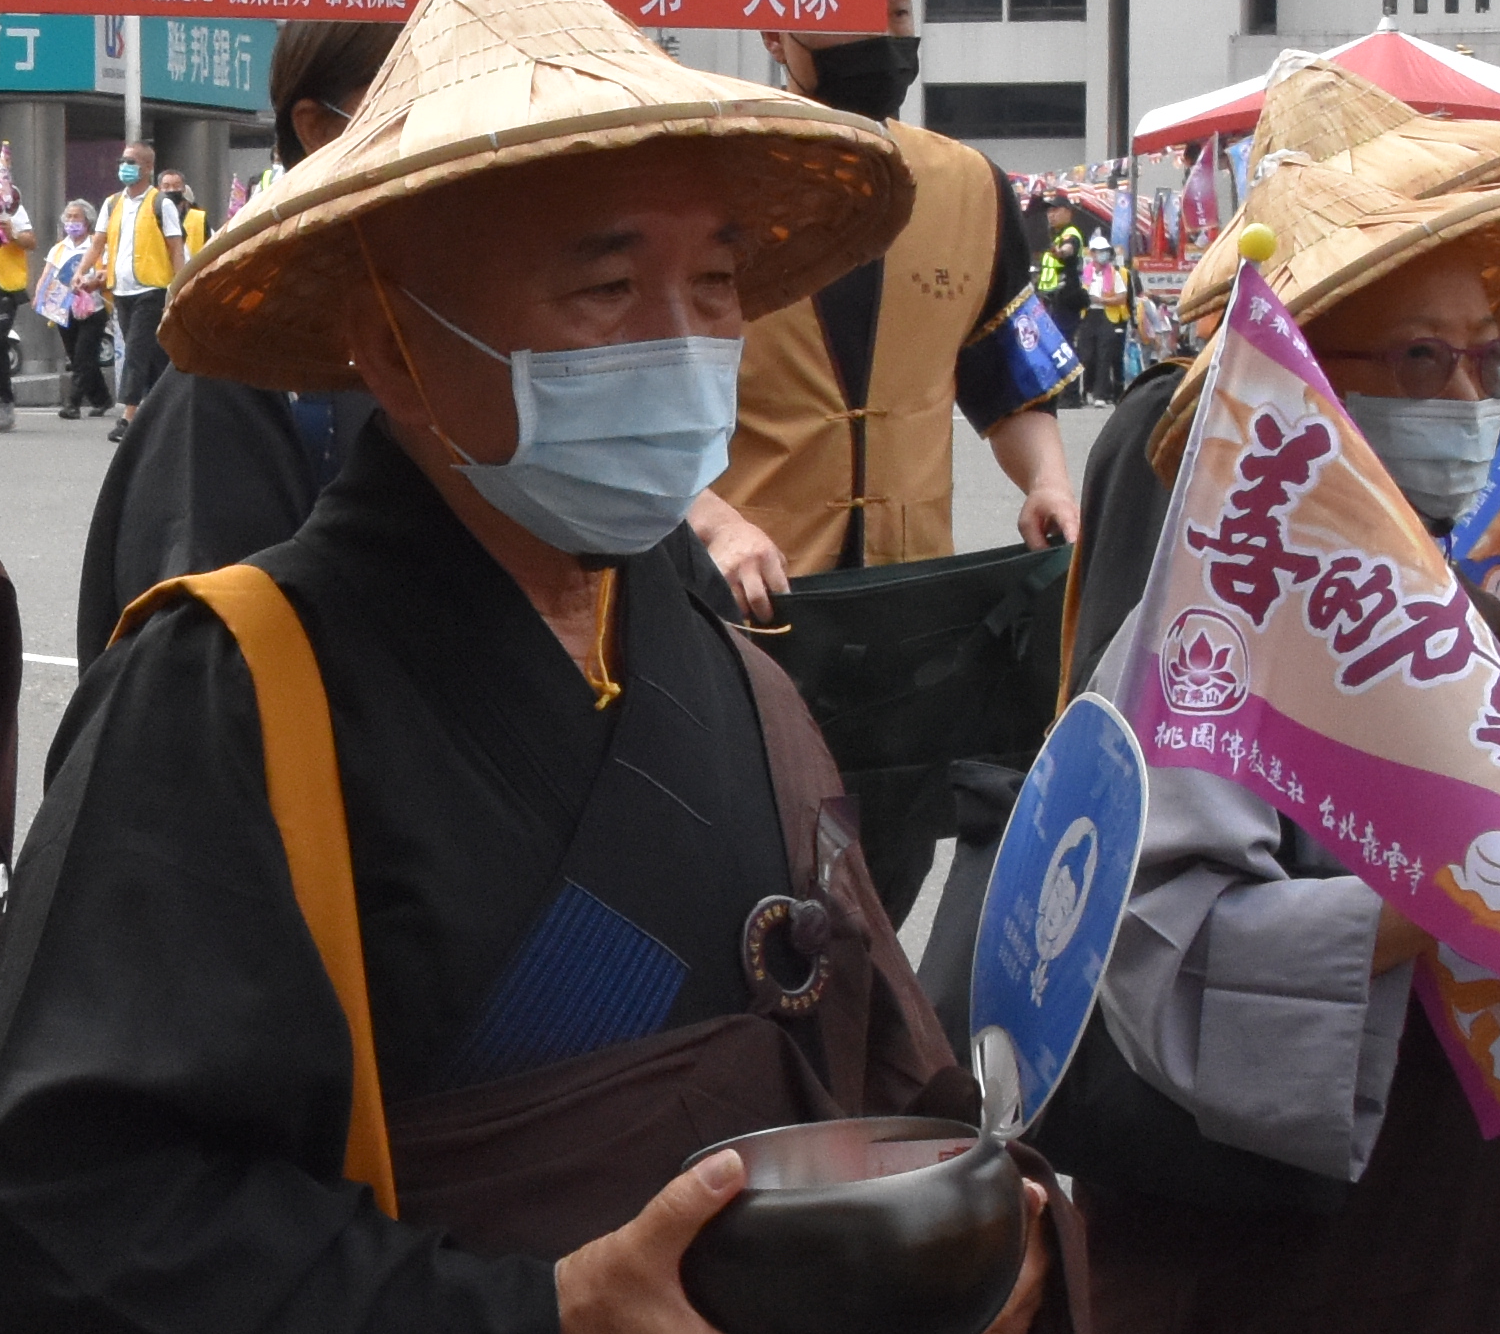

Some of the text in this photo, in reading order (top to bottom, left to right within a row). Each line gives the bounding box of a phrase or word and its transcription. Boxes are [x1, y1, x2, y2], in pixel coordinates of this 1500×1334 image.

[166, 20, 253, 92] 聯邦銀行
[1154, 720, 1306, 805] 桃園佛教蓮社
